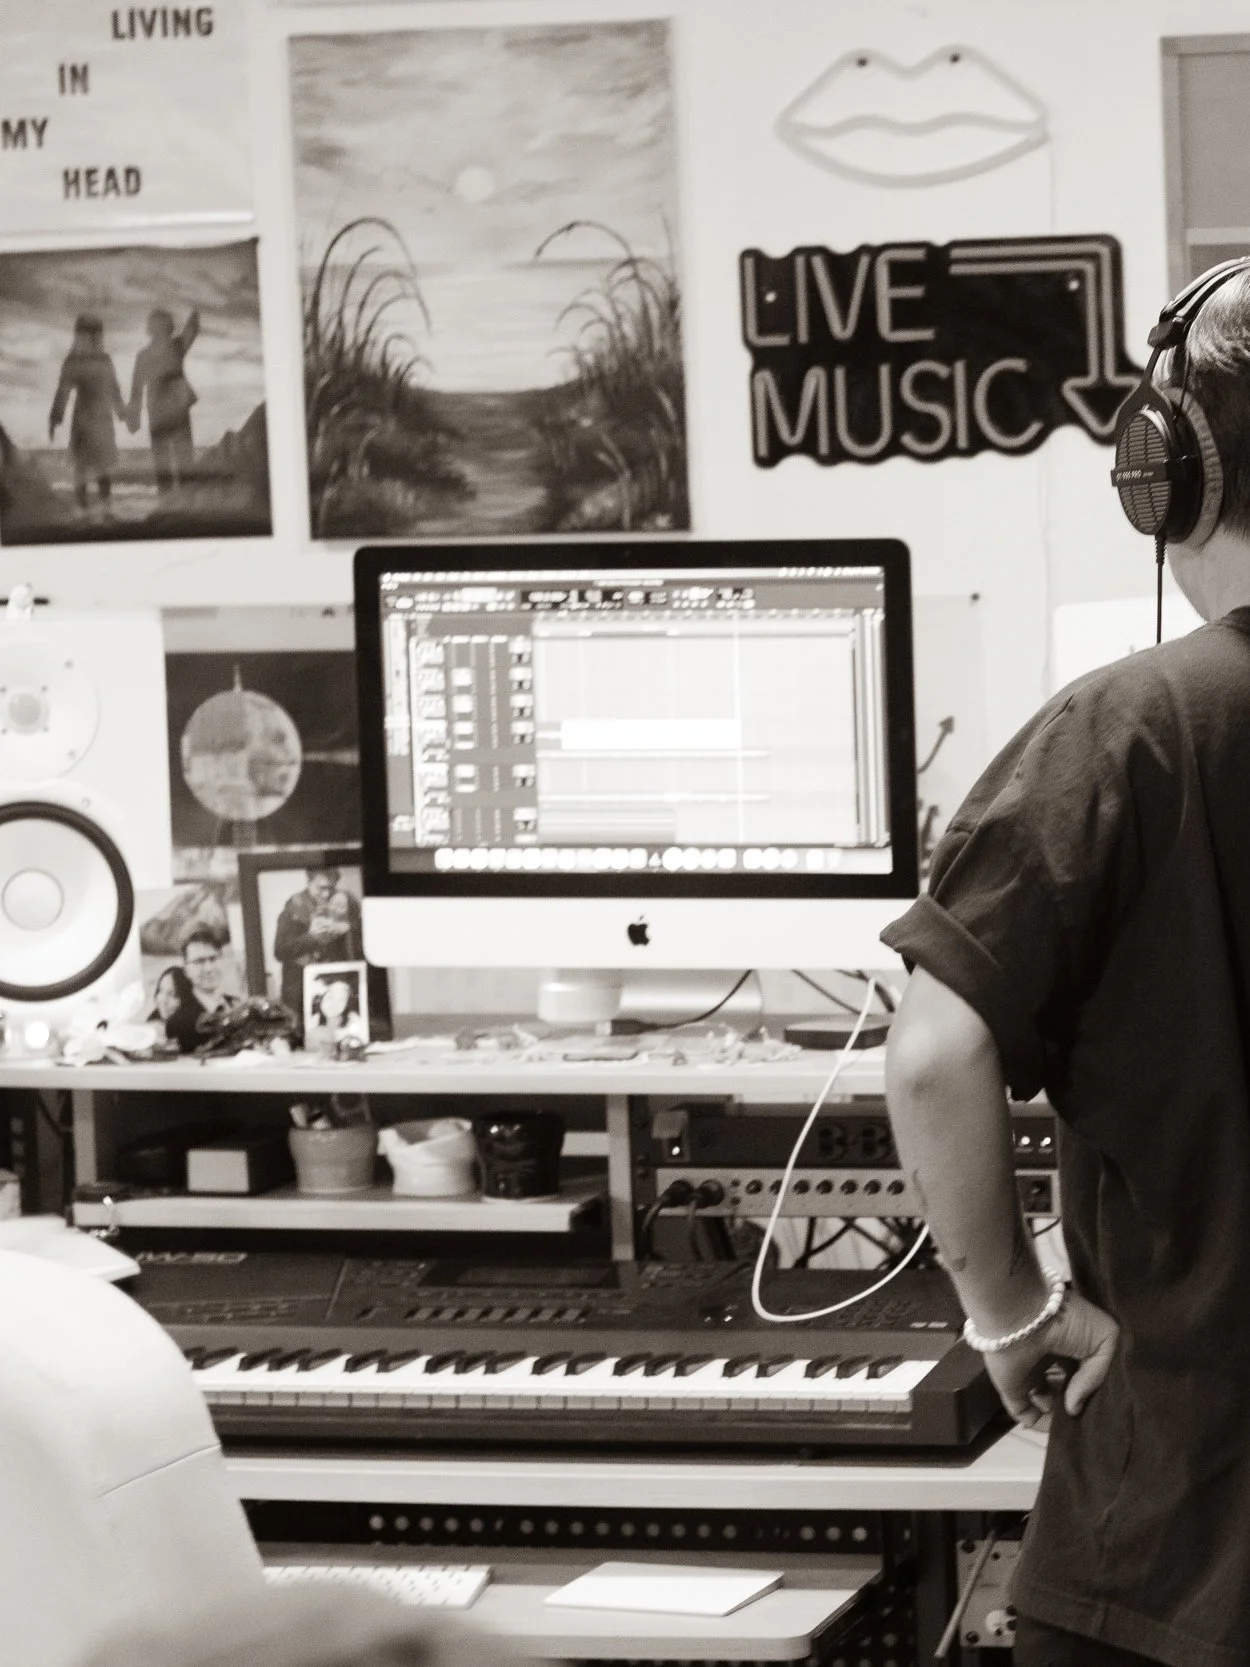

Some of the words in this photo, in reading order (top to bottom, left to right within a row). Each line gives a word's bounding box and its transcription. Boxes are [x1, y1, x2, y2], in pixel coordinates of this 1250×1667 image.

[111, 7, 214, 40] LIVING
[58, 63, 88, 95] IN
[1, 118, 48, 149] MY
[62, 166, 141, 199] HEAD
[743, 248, 936, 346] LIVE
[753, 358, 1043, 457] MUSIC
